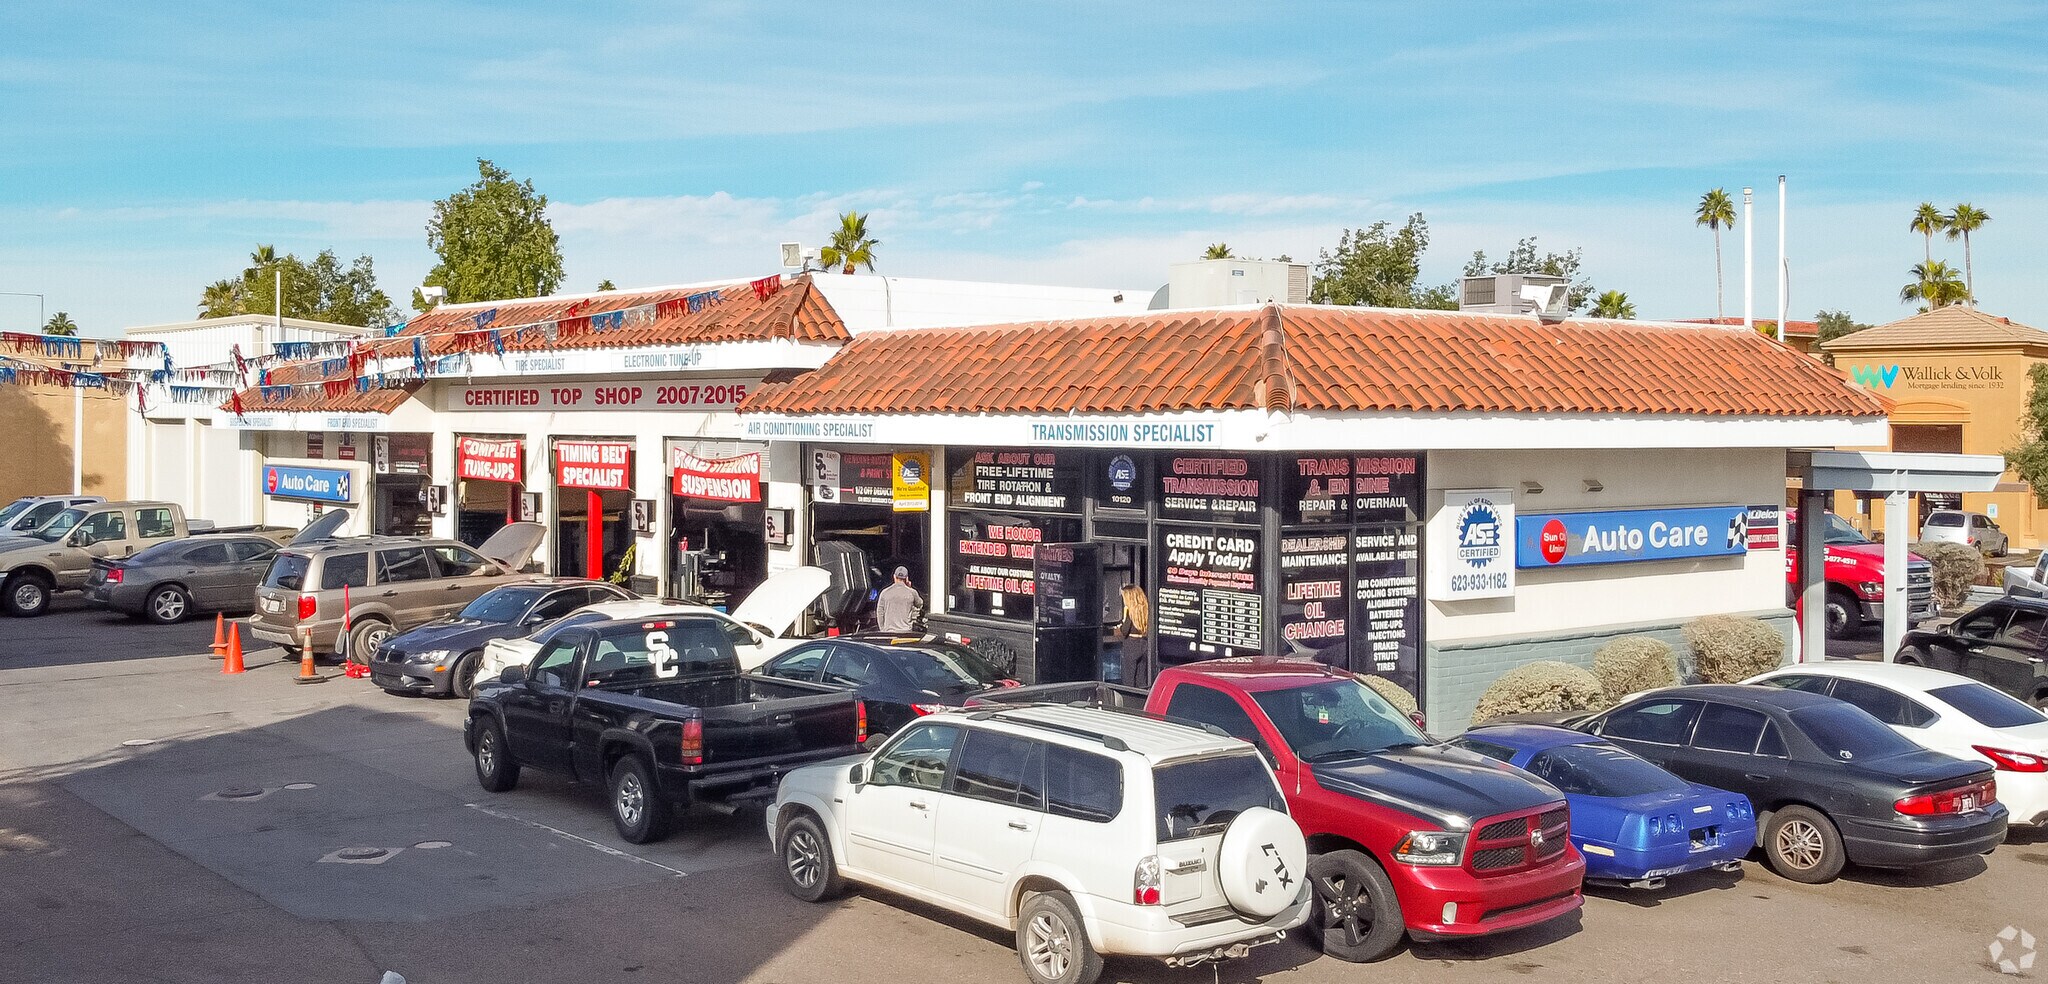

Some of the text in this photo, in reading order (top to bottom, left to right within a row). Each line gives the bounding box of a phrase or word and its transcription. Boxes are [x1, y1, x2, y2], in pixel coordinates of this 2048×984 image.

[530, 358, 566, 371] SPECIALIST
[624, 350, 703, 368] ELECTRONIC TUNE-UP
[1902, 365, 2003, 381] Wallick & Volk
[1907, 382, 1940, 391] Mortgage
[1941, 382, 1967, 391] lending
[1988, 381, 2004, 389] 1932
[465, 389, 540, 406] CERTIFIED
[551, 388, 582, 405] TOP
[594, 386, 643, 405] SHOP
[327, 418, 341, 428] FRONT
[352, 418, 378, 429] SPECIALIST
[748, 421, 873, 438] AIR CONDITIONING SPECIALIST
[1032, 424, 1214, 442] TRANSMISSION SPECIALIST
[463, 438, 517, 459] COMPLETE
[559, 445, 628, 464] TIMING BELT
[975, 452, 1056, 465] ASK ABOUT OUR
[1173, 458, 1248, 476] CERTIFIED
[1297, 457, 1416, 476] TRANS MISSION
[464, 459, 515, 480] TUNE-UPS
[563, 467, 624, 487] SPECIALIST
[976, 466, 1054, 479] FREE-LIFETIME
[1115, 470, 1130, 479] ASE
[281, 473, 304, 491] Auto
[305, 474, 330, 493] Care
[681, 473, 751, 499] SUSPENSION
[855, 485, 863, 495] 1/2
[864, 486, 873, 496] OFF
[977, 480, 1052, 493] TIRE ROTATION &
[1163, 477, 1259, 497] TRANSMISSION
[1310, 477, 1389, 496] & EN GINE
[964, 493, 1066, 508] FRONT END ALIGNMENT
[1112, 495, 1132, 504] 10120
[1164, 497, 1207, 510] SERVICE
[1299, 496, 1408, 511] REPAIR & OVERHAUL
[988, 524, 1041, 541] WE HONOR
[1463, 522, 1495, 546] ASE
[1543, 532, 1558, 542] Sun
[1582, 521, 1709, 553] Auto Care
[960, 539, 1007, 556] EXTENDED
[1166, 533, 1255, 553] CREDIT CARD
[1281, 534, 1417, 553] DEALERSHIP SERVICE AND
[1168, 548, 1253, 571] Apply Today!
[1282, 550, 1418, 568] MAINTENANCE AVAILABLE HERE
[1459, 547, 1499, 558] CERTIFIED
[970, 564, 981, 573] ASK
[982, 566, 997, 575] ABOUT
[997, 567, 1008, 576] OUR
[1009, 568, 1034, 579] CUSTOME
[966, 574, 1003, 592] LIFETIME
[1005, 577, 1020, 593] OIL
[1287, 580, 1342, 600] LIFETIME
[1357, 577, 1416, 589] AIR CONDITIONING
[1451, 571, 1507, 592] 623-933-1182
[1357, 586, 1417, 599] COOLING SYSTEMS
[1304, 602, 1326, 619] OIL
[1367, 598, 1408, 610] ALIGNMENTS
[1369, 609, 1405, 620] BATTERIES
[1285, 619, 1345, 640] CHANGE
[1371, 620, 1403, 631] TUNE-UPS
[1367, 630, 1406, 641] INJECTIONS
[1373, 641, 1399, 652] BRAKES
[1373, 651, 1399, 662] STRUTS
[1376, 661, 1396, 672] TIRES
[1260, 842, 1294, 891] XL-7
